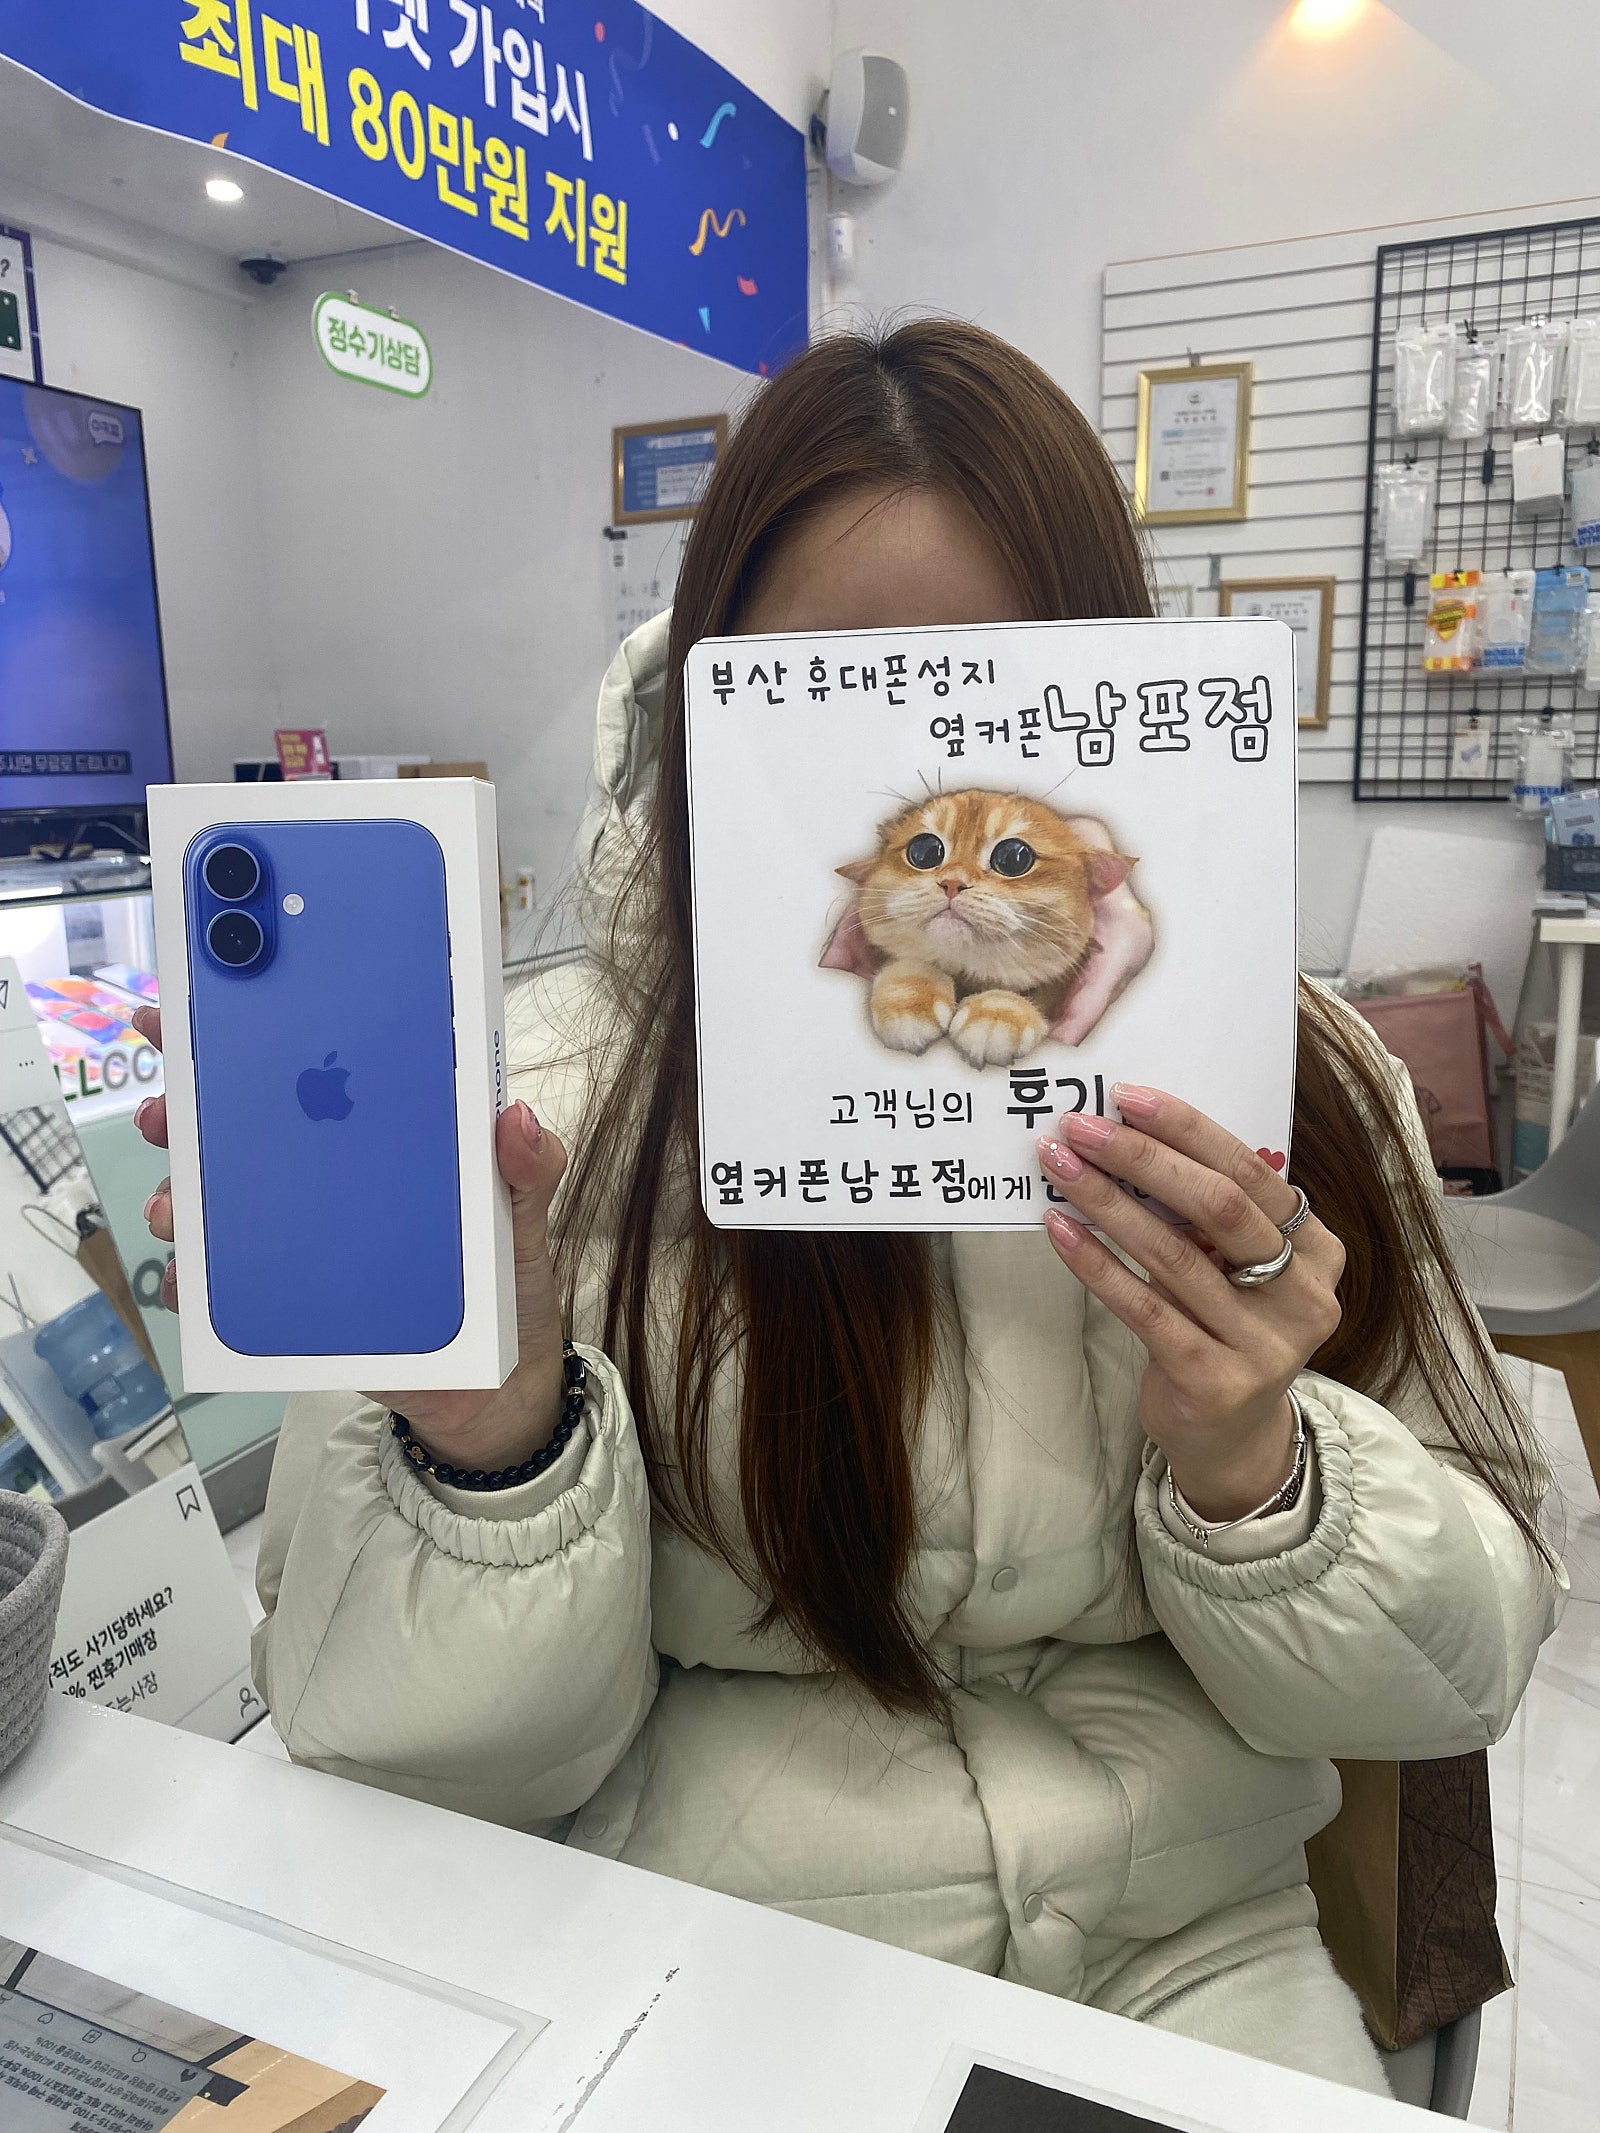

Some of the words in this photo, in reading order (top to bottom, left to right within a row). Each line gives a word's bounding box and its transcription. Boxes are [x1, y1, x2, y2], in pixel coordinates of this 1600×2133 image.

[449, 0, 594, 162] 가입시
[178, 0, 330, 147] 최대
[347, 67, 530, 241] 80만원
[544, 170, 628, 286] 지원
[711, 660, 787, 706] 부산
[808, 654, 996, 706] 휴대폰성지
[930, 706, 1043, 758] 옆커폰
[1044, 674, 1273, 768] 남포점
[829, 1088, 973, 1130] 고객님의
[49, 1649, 84, 1689] 직도
[86, 1586, 174, 1657] 사기당하세요?
[86, 1627, 158, 1691] 찐후기매장
[20, 2068, 44, 2082] 100%
[125, 2114, 153, 2131] 아무리
